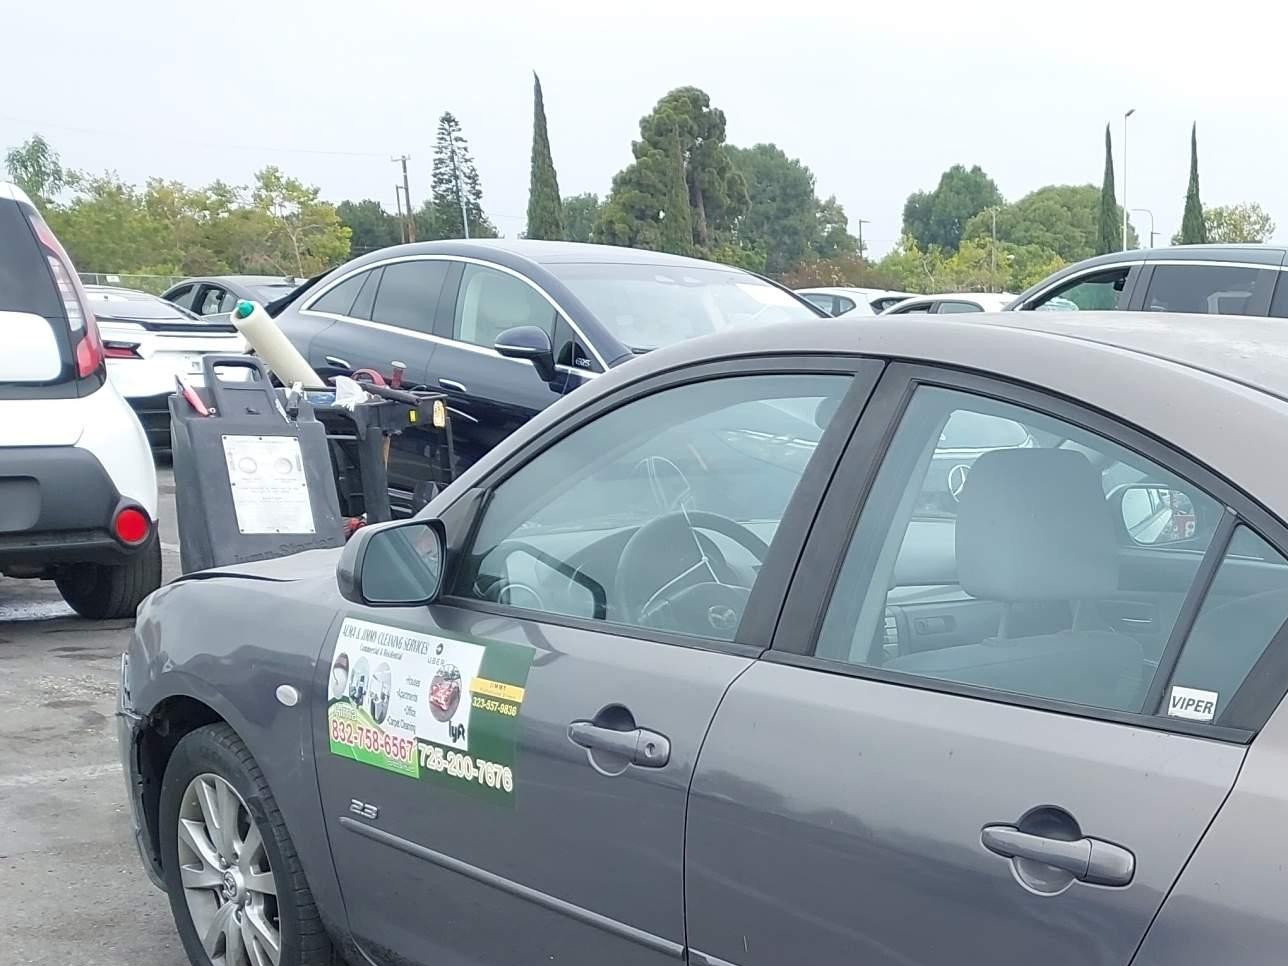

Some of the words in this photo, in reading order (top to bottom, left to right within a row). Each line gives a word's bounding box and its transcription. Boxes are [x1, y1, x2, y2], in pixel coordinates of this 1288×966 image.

[1172, 695, 1214, 715] VIPER
[331, 719, 415, 762] 832-758-6567
[417, 743, 513, 792] 725-200-7676
